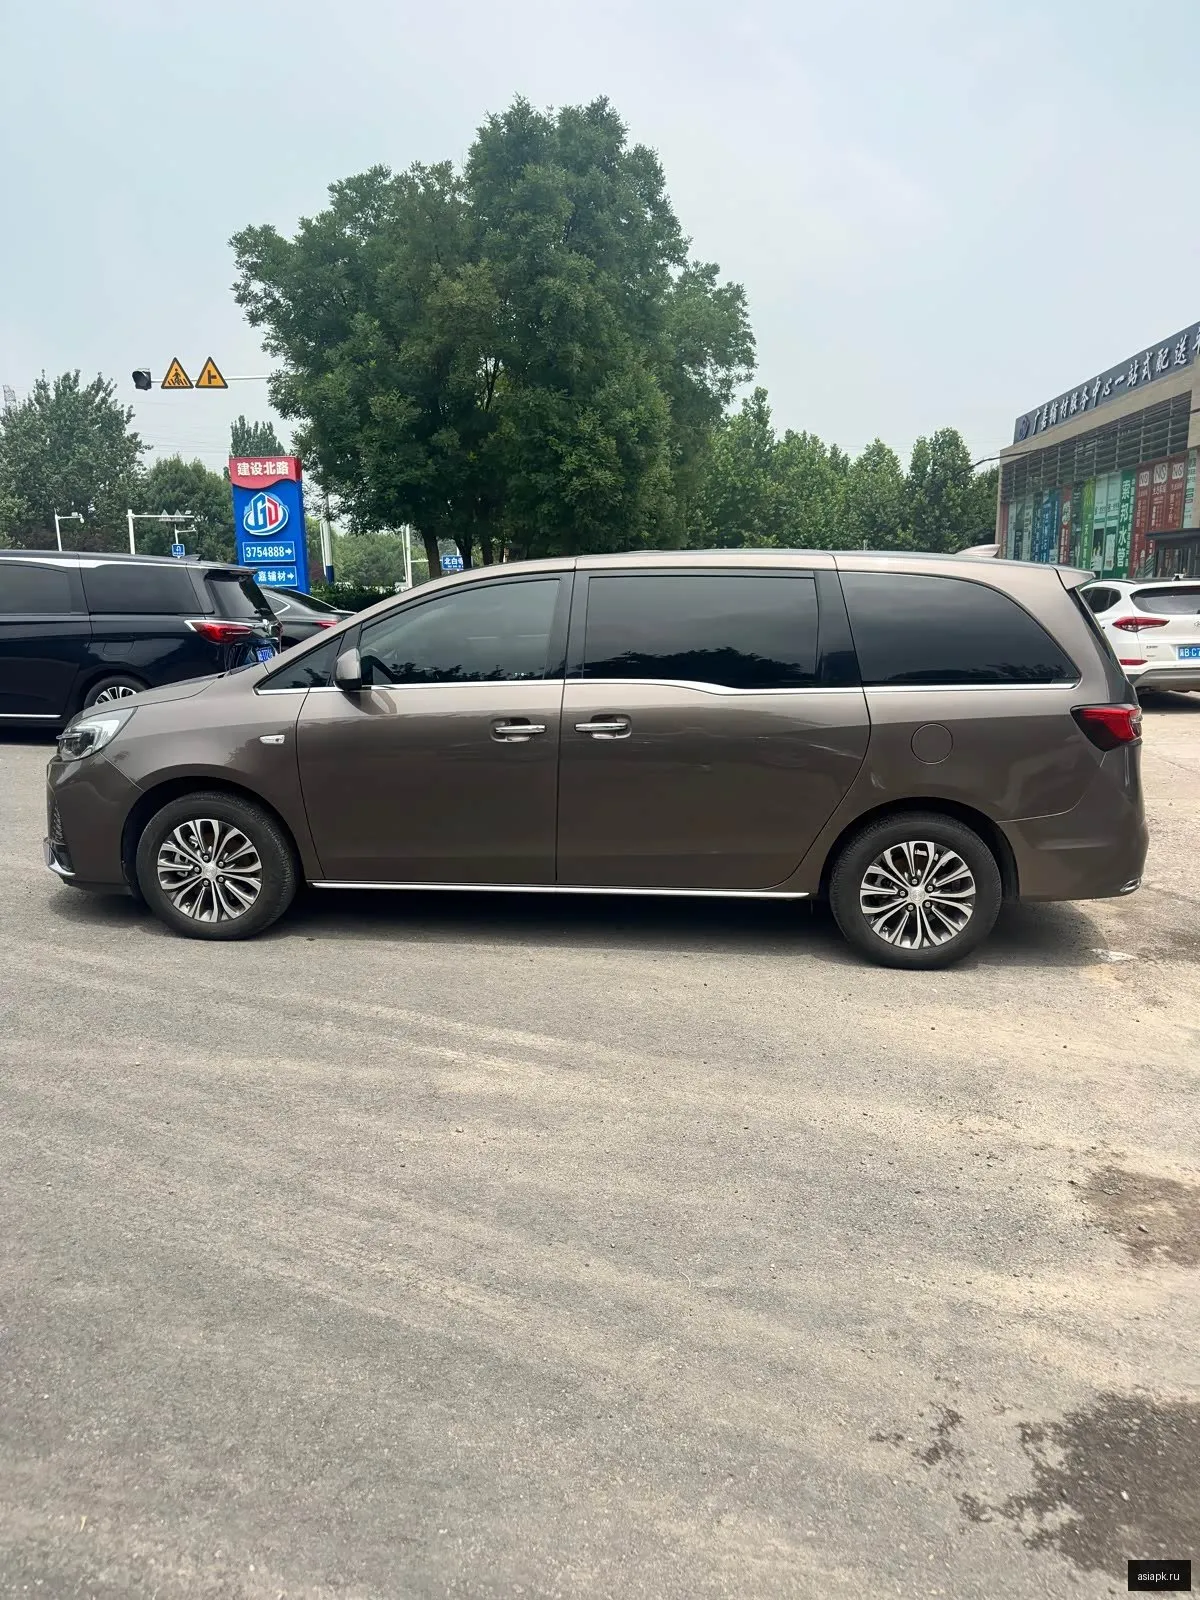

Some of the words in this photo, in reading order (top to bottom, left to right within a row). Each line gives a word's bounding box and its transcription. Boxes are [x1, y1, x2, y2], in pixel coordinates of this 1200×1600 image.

[237, 461, 289, 476] 建设北路
[246, 547, 285, 558] 3754888
